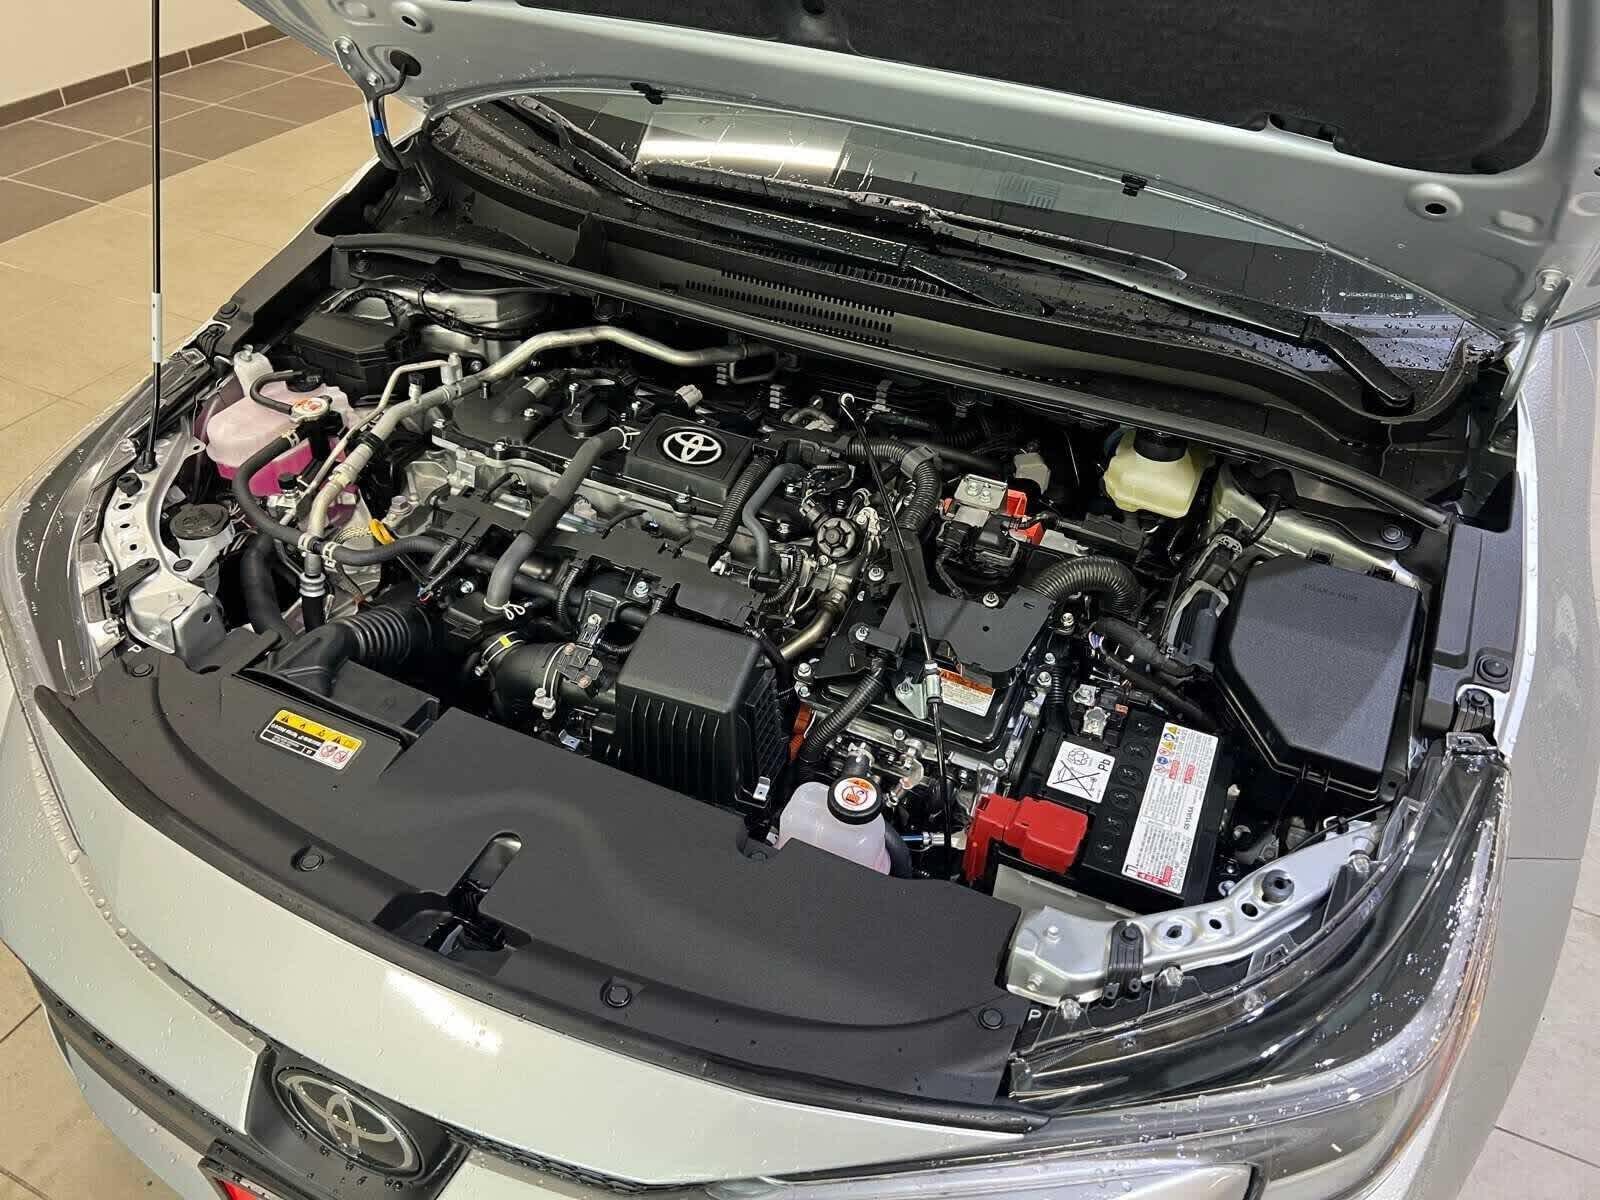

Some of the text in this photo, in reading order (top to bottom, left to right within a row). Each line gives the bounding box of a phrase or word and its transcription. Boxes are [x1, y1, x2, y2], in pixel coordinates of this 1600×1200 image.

[128, 644, 142, 653] P
[1098, 759, 1111, 771] Pb
[1028, 1009, 1042, 1021] P
